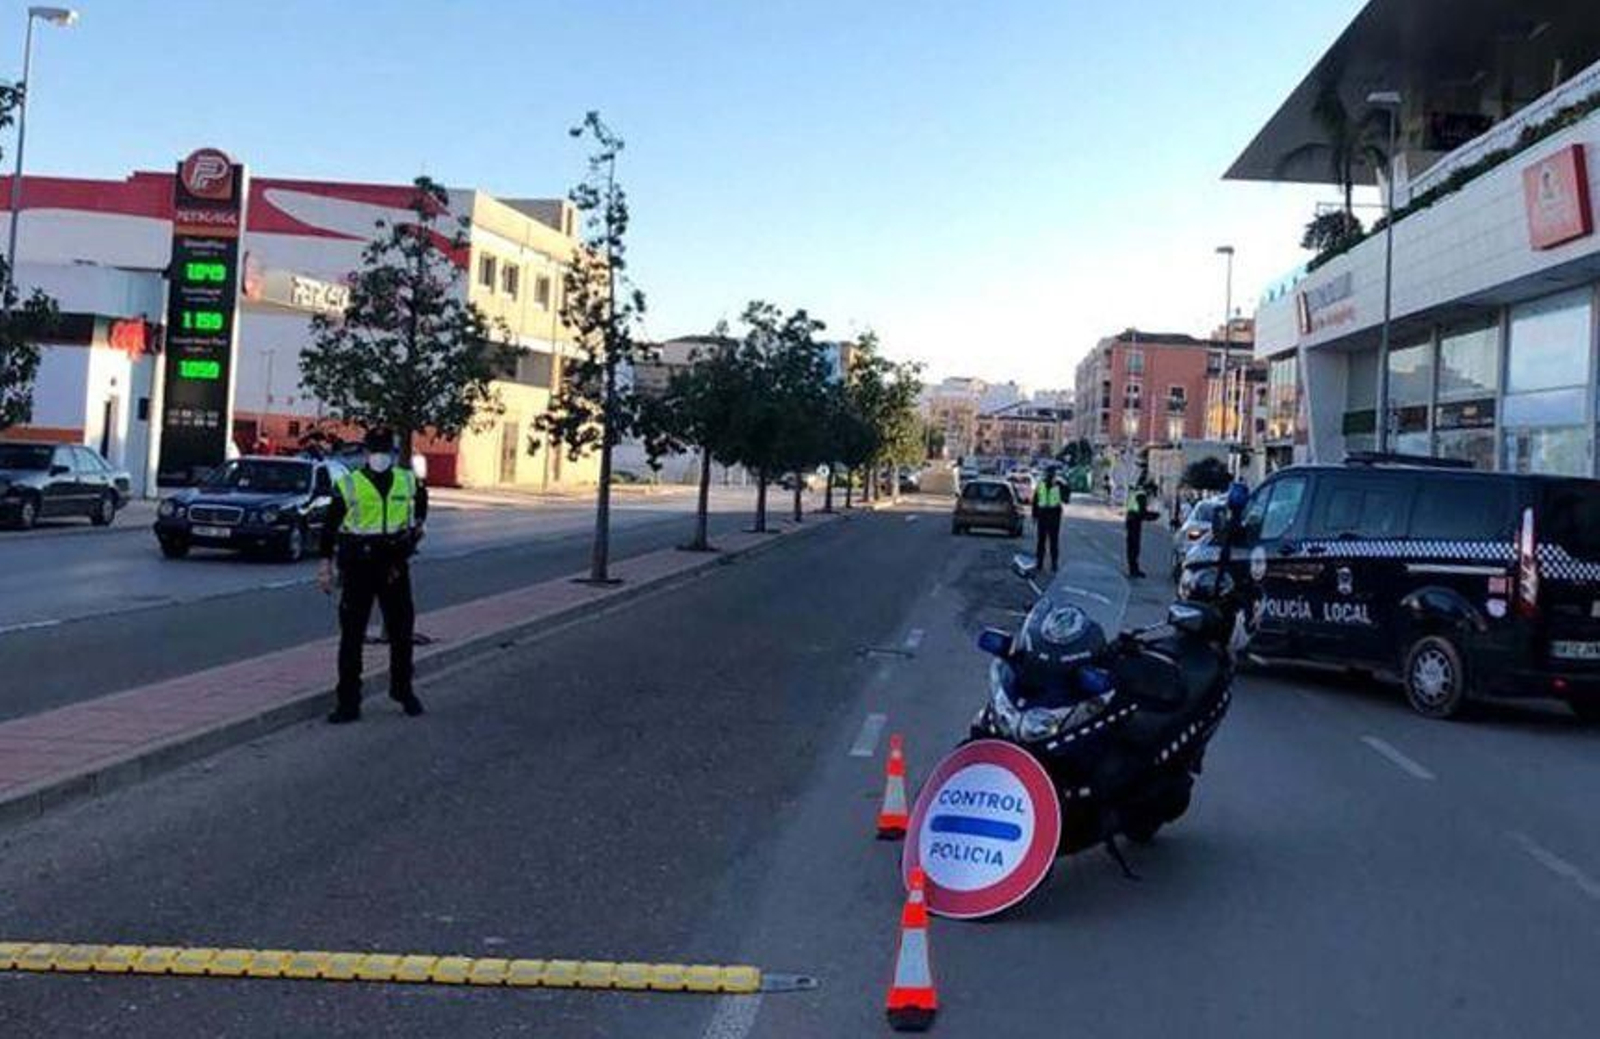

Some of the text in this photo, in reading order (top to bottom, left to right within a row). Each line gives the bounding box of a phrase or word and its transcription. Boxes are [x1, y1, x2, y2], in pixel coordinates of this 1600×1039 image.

[1323, 601, 1373, 624] LOCAL
[938, 789, 1025, 813] CONTROL
[929, 842, 1004, 867] POLICIA
